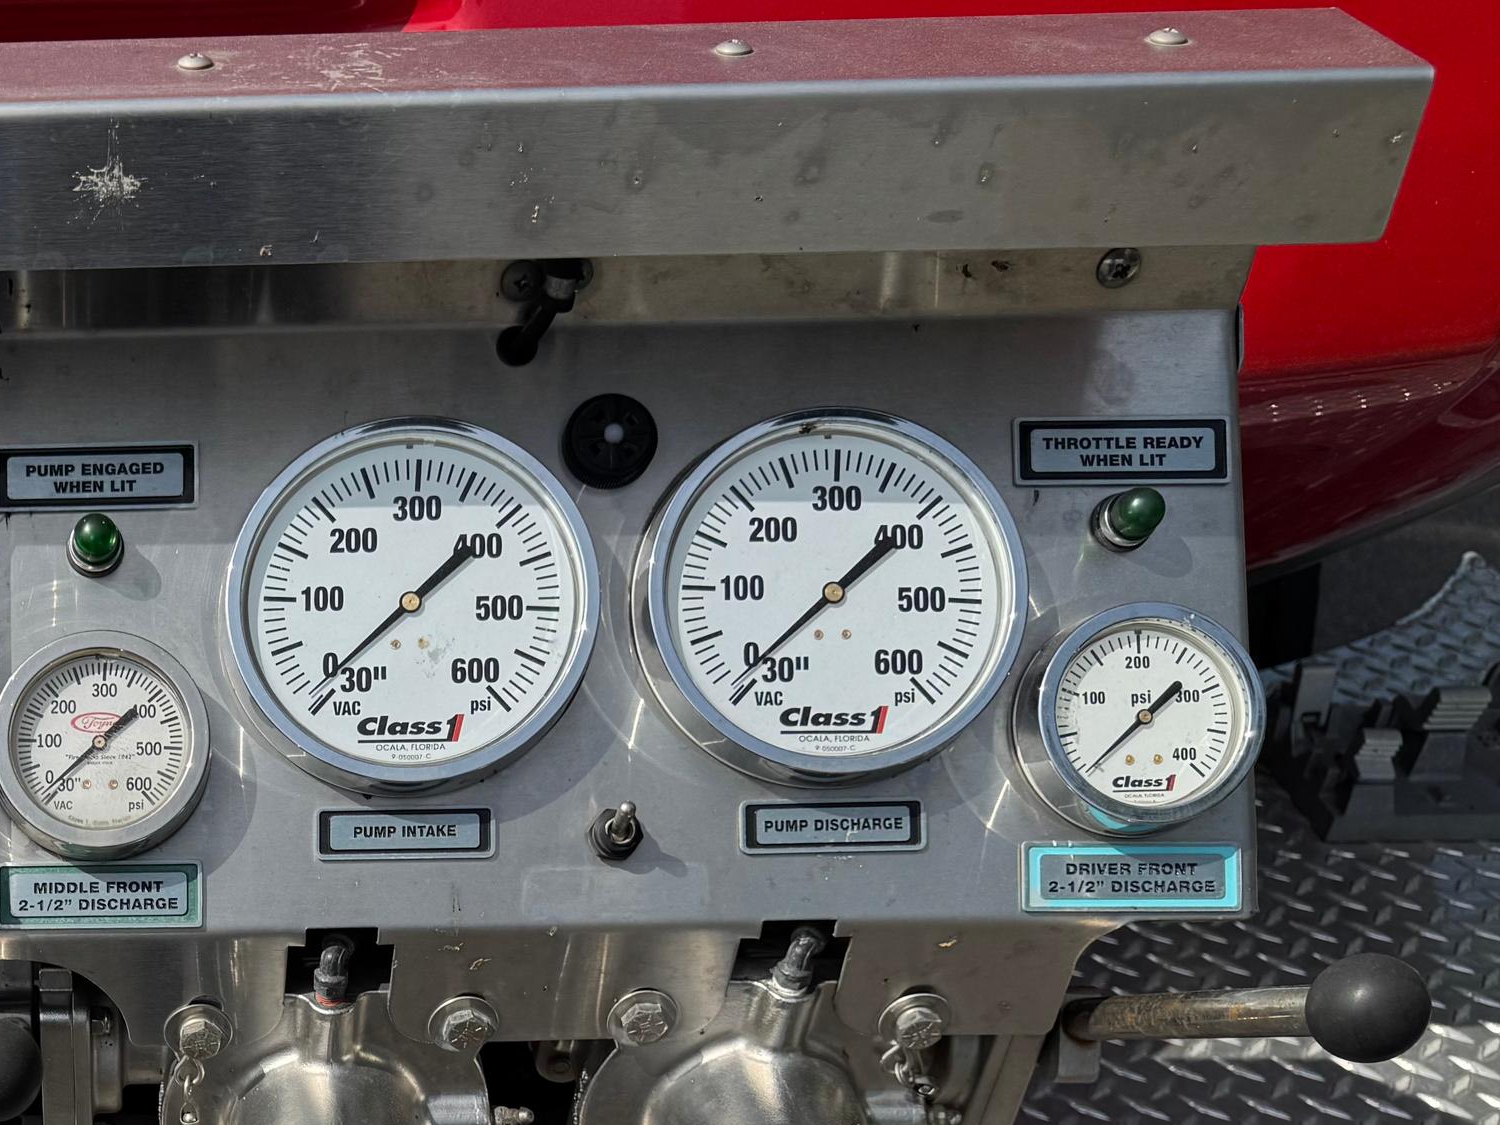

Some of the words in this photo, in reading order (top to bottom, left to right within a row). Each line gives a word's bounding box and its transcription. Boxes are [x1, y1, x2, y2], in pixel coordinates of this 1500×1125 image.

[1043, 437, 1137, 449] THROTTLE
[1143, 436, 1203, 448] READY
[1080, 455, 1133, 466] WHEN
[1140, 454, 1166, 466] LIT
[26, 464, 75, 477] PUMP
[81, 462, 164, 476] ENGAGED
[54, 481, 104, 493] WHEN
[111, 480, 136, 492] LIT
[812, 486, 861, 511] 300
[393, 495, 442, 520] 300
[749, 518, 797, 542] 200
[329, 528, 378, 553] 200
[720, 576, 764, 601] 100
[301, 586, 344, 612] 100
[898, 587, 946, 612] 500
[475, 596, 523, 620] 500
[874, 650, 923, 675] 600
[1125, 656, 1150, 669] 200
[451, 658, 500, 683] 600
[92, 684, 117, 697] 300
[895, 689, 915, 706] psi
[471, 696, 491, 714] psi
[755, 692, 783, 706] VAC
[1083, 692, 1105, 704] 100
[1131, 690, 1151, 706] psi
[51, 700, 76, 714] 200
[333, 701, 361, 715] VAC
[38, 734, 62, 748] 100
[136, 742, 162, 755] 500
[1173, 748, 1196, 760] 400
[127, 777, 152, 791] 600
[54, 800, 73, 809] VAC
[129, 800, 143, 811] psi
[354, 827, 396, 838] PUMP
[402, 825, 456, 837] INTAKE
[764, 820, 808, 832] PUMP
[814, 818, 903, 831] DISCHARGE
[1066, 863, 1131, 875] DRIVER
[1138, 863, 1198, 875] FRONT
[33, 882, 99, 894] MIDDLE
[107, 881, 163, 893] FRONT
[1111, 881, 1215, 892] DISCHARGE
[79, 898, 178, 910] DISCHARGE
